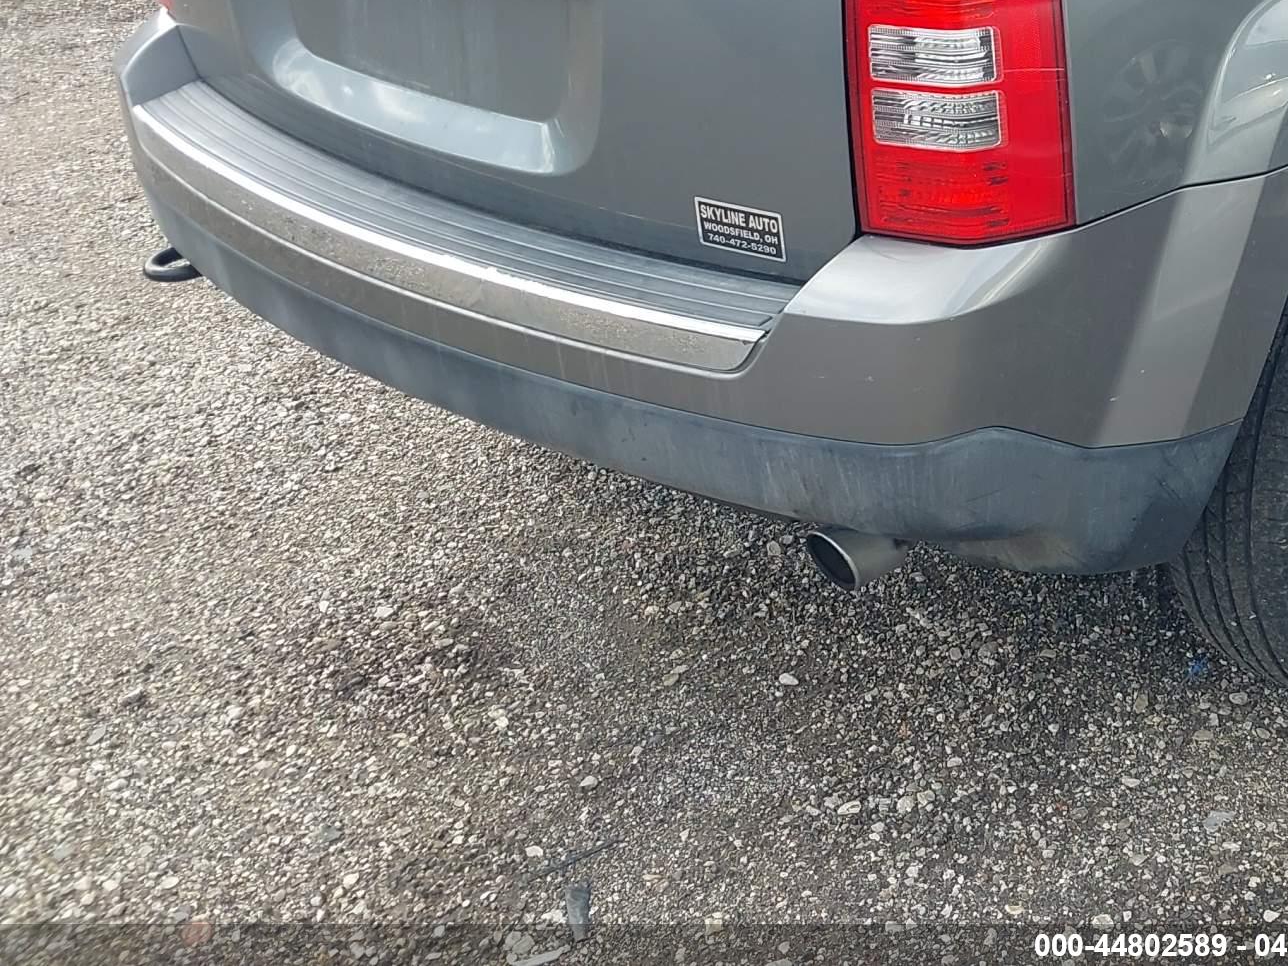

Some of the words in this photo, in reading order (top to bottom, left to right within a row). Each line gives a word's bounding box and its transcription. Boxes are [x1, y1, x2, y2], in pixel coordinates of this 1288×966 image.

[700, 204, 746, 227] SKYLINE
[748, 214, 778, 234] AUTO
[703, 221, 763, 243] WOODSFIELD,
[764, 234, 778, 245] OH
